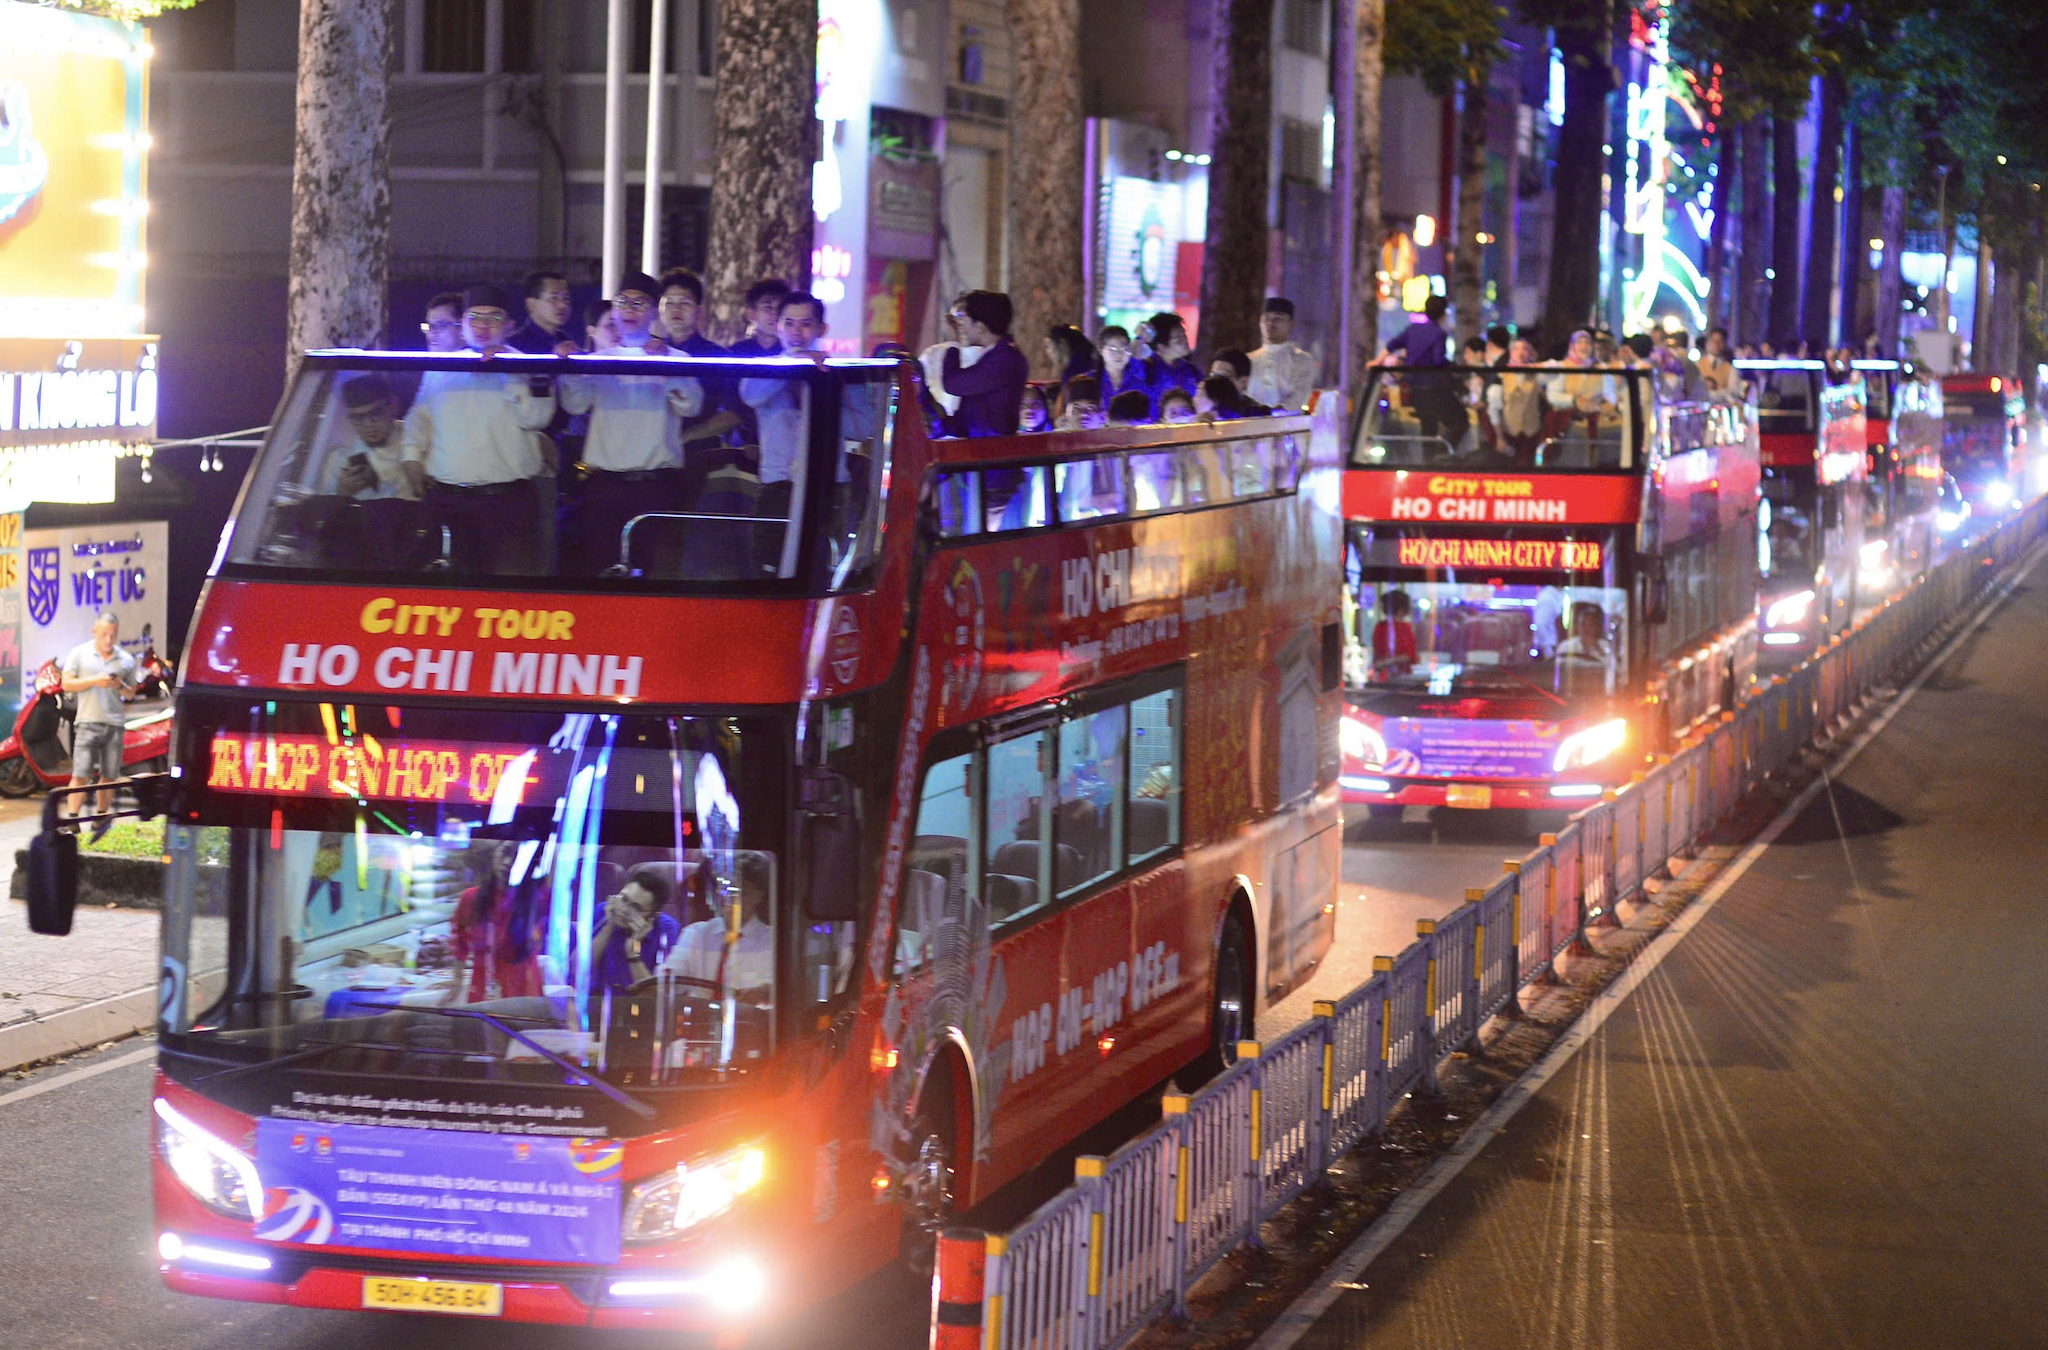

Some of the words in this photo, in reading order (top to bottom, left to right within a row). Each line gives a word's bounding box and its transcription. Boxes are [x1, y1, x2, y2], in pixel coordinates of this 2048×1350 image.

[1392, 497, 1432, 519] HO
[1438, 498, 1488, 520] CHI
[1493, 499, 1568, 521] MINH
[1429, 476, 1479, 495] CITY
[1483, 481, 1533, 496] TOUR
[1400, 538, 1428, 565] HO
[1429, 539, 1462, 565] CHI
[1463, 540, 1513, 567] MINH
[1513, 541, 1556, 568] CITY
[71, 560, 116, 613] VIỆT
[119, 557, 147, 602] ÚC
[1062, 556, 1094, 620] HO
[1096, 548, 1130, 613] CHI
[360, 597, 462, 637] CITY
[473, 608, 576, 641] TOUR
[278, 643, 360, 686] HO
[374, 647, 474, 692] CHI
[490, 652, 644, 697] MINH
[248, 741, 321, 791] HOP
[327, 746, 382, 796] ON
[385, 748, 461, 799] HOP
[1011, 1002, 1053, 1084] HOP
[1056, 961, 1129, 1058] ON-HOP
